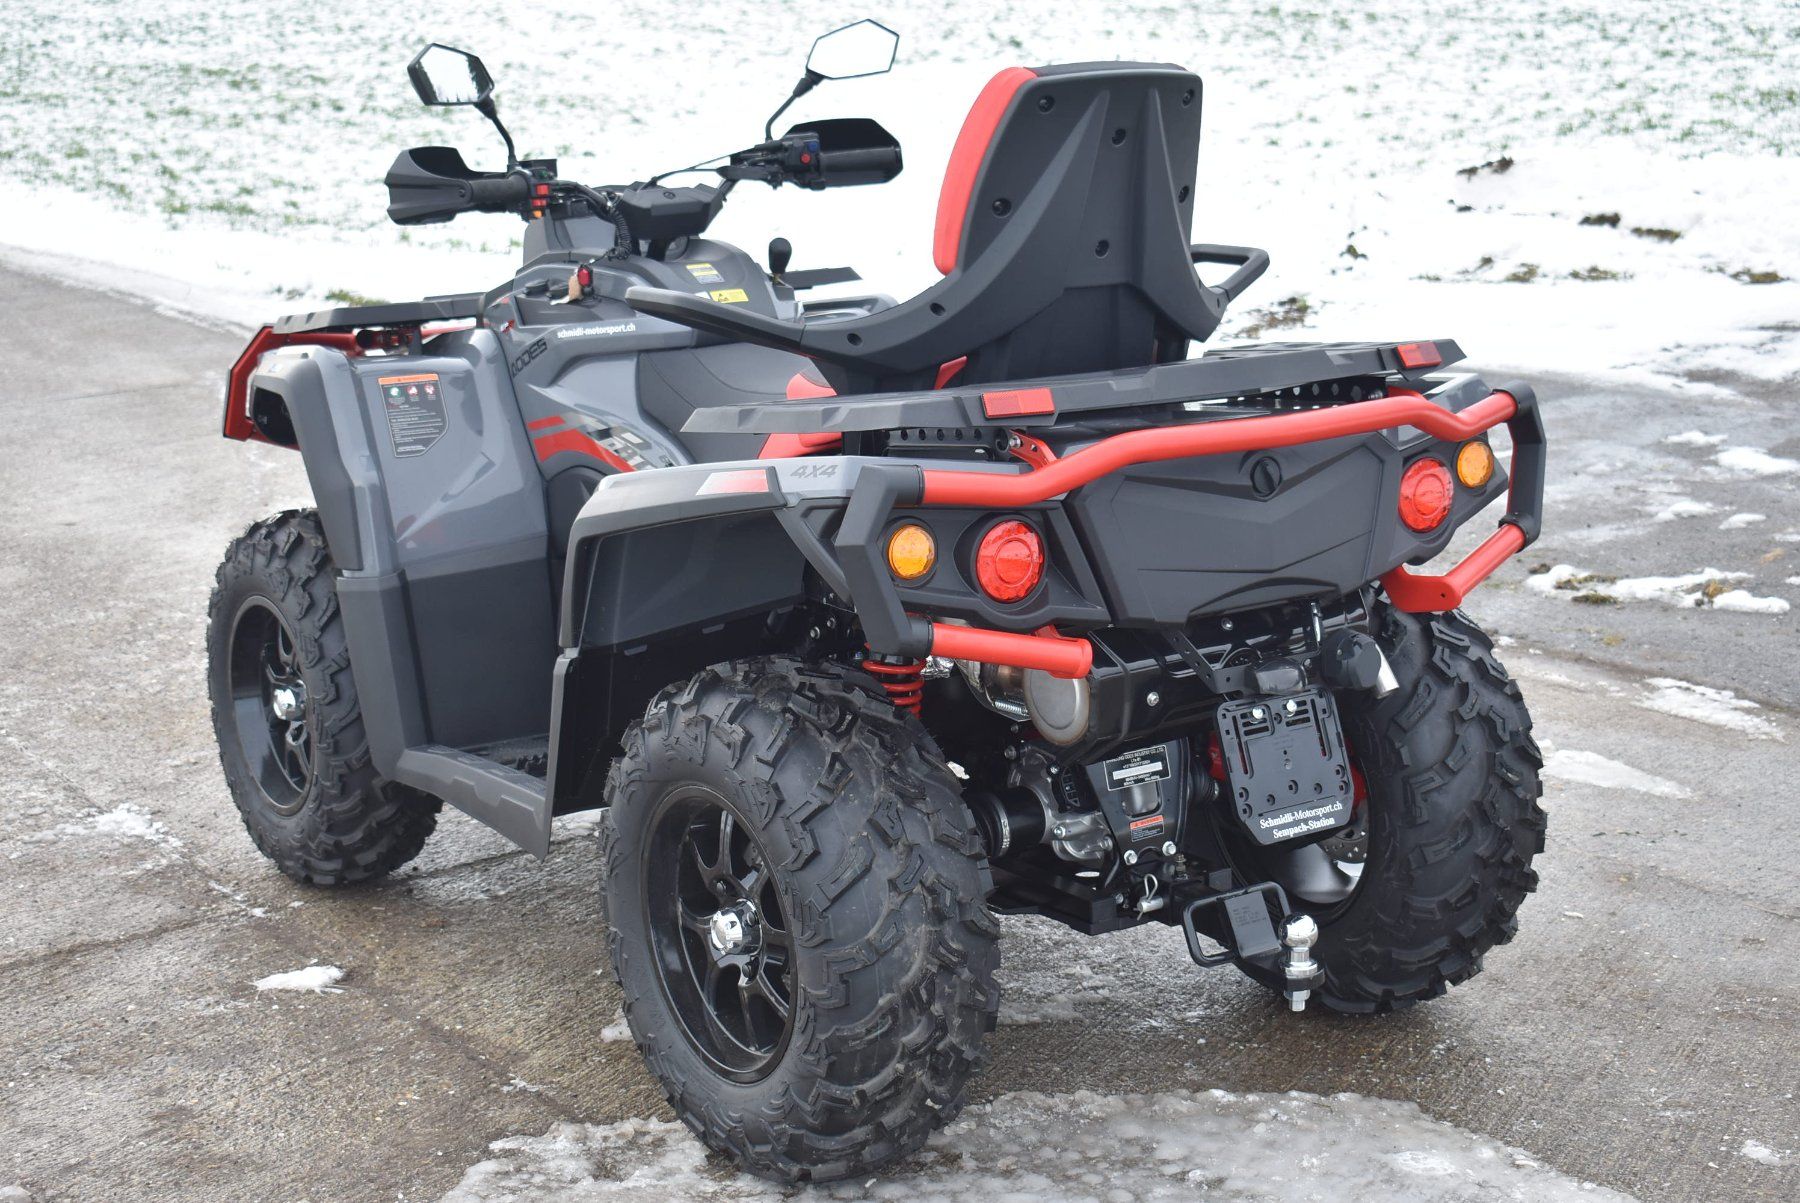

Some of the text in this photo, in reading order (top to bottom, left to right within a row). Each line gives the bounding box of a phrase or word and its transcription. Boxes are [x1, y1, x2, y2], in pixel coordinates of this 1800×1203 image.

[557, 323, 636, 338] schmidli-motorsport.ch
[1259, 801, 1343, 829] Schmidli-Motorsport.ch
[1272, 816, 1336, 840] Sempach-Station
